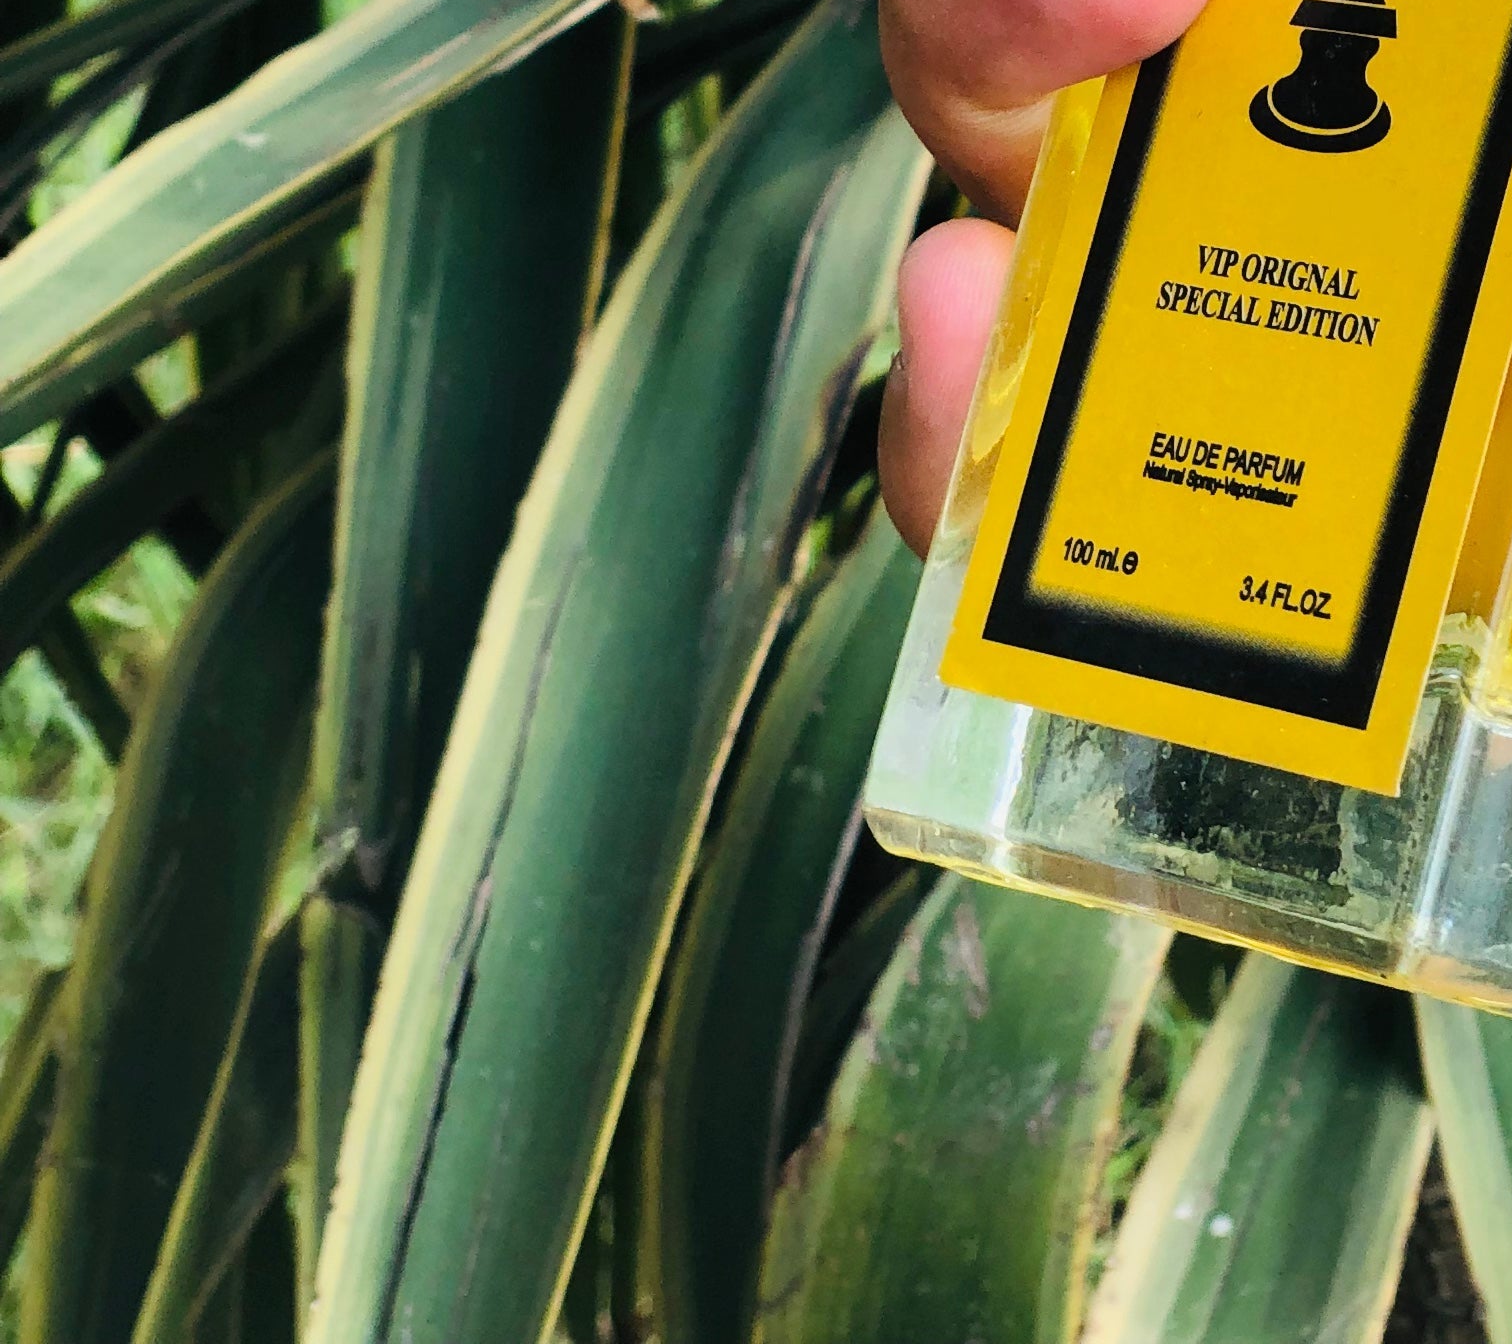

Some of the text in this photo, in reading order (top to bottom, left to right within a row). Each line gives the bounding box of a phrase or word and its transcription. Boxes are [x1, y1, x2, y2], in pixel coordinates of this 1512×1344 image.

[1199, 245, 1360, 300] VIP ORIGNAL
[1156, 281, 1381, 347] SPECIAL EDITION
[1150, 432, 1306, 486] EAU DE PARFUM
[1064, 537, 1094, 566] 100
[1239, 576, 1270, 605] 3.4
